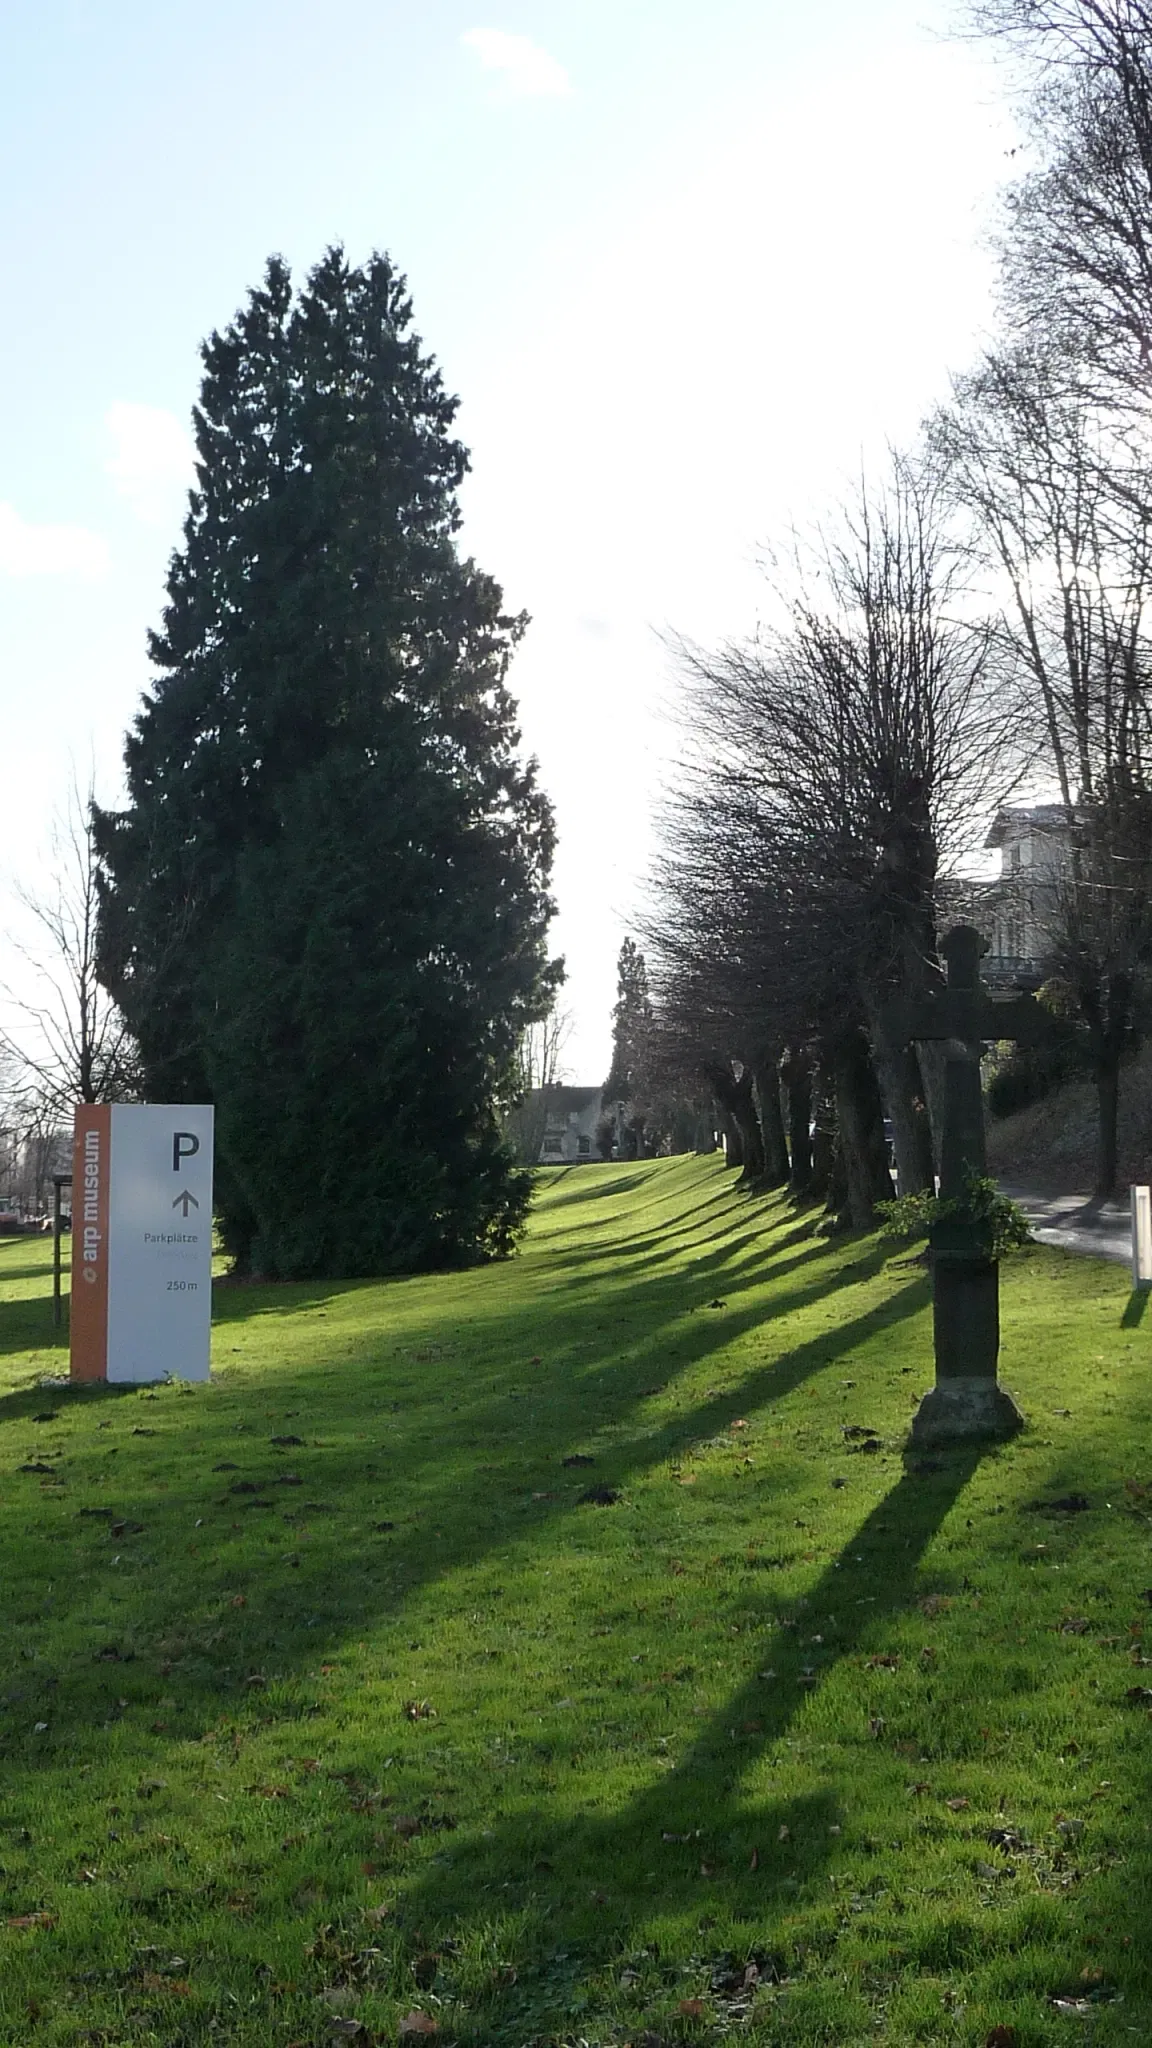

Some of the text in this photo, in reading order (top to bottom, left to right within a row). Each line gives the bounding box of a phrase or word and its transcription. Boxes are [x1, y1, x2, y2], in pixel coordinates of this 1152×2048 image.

[173, 1132, 200, 1171] P
[83, 1130, 101, 1262] arp museum
[144, 1232, 199, 1245] Parkplätze
